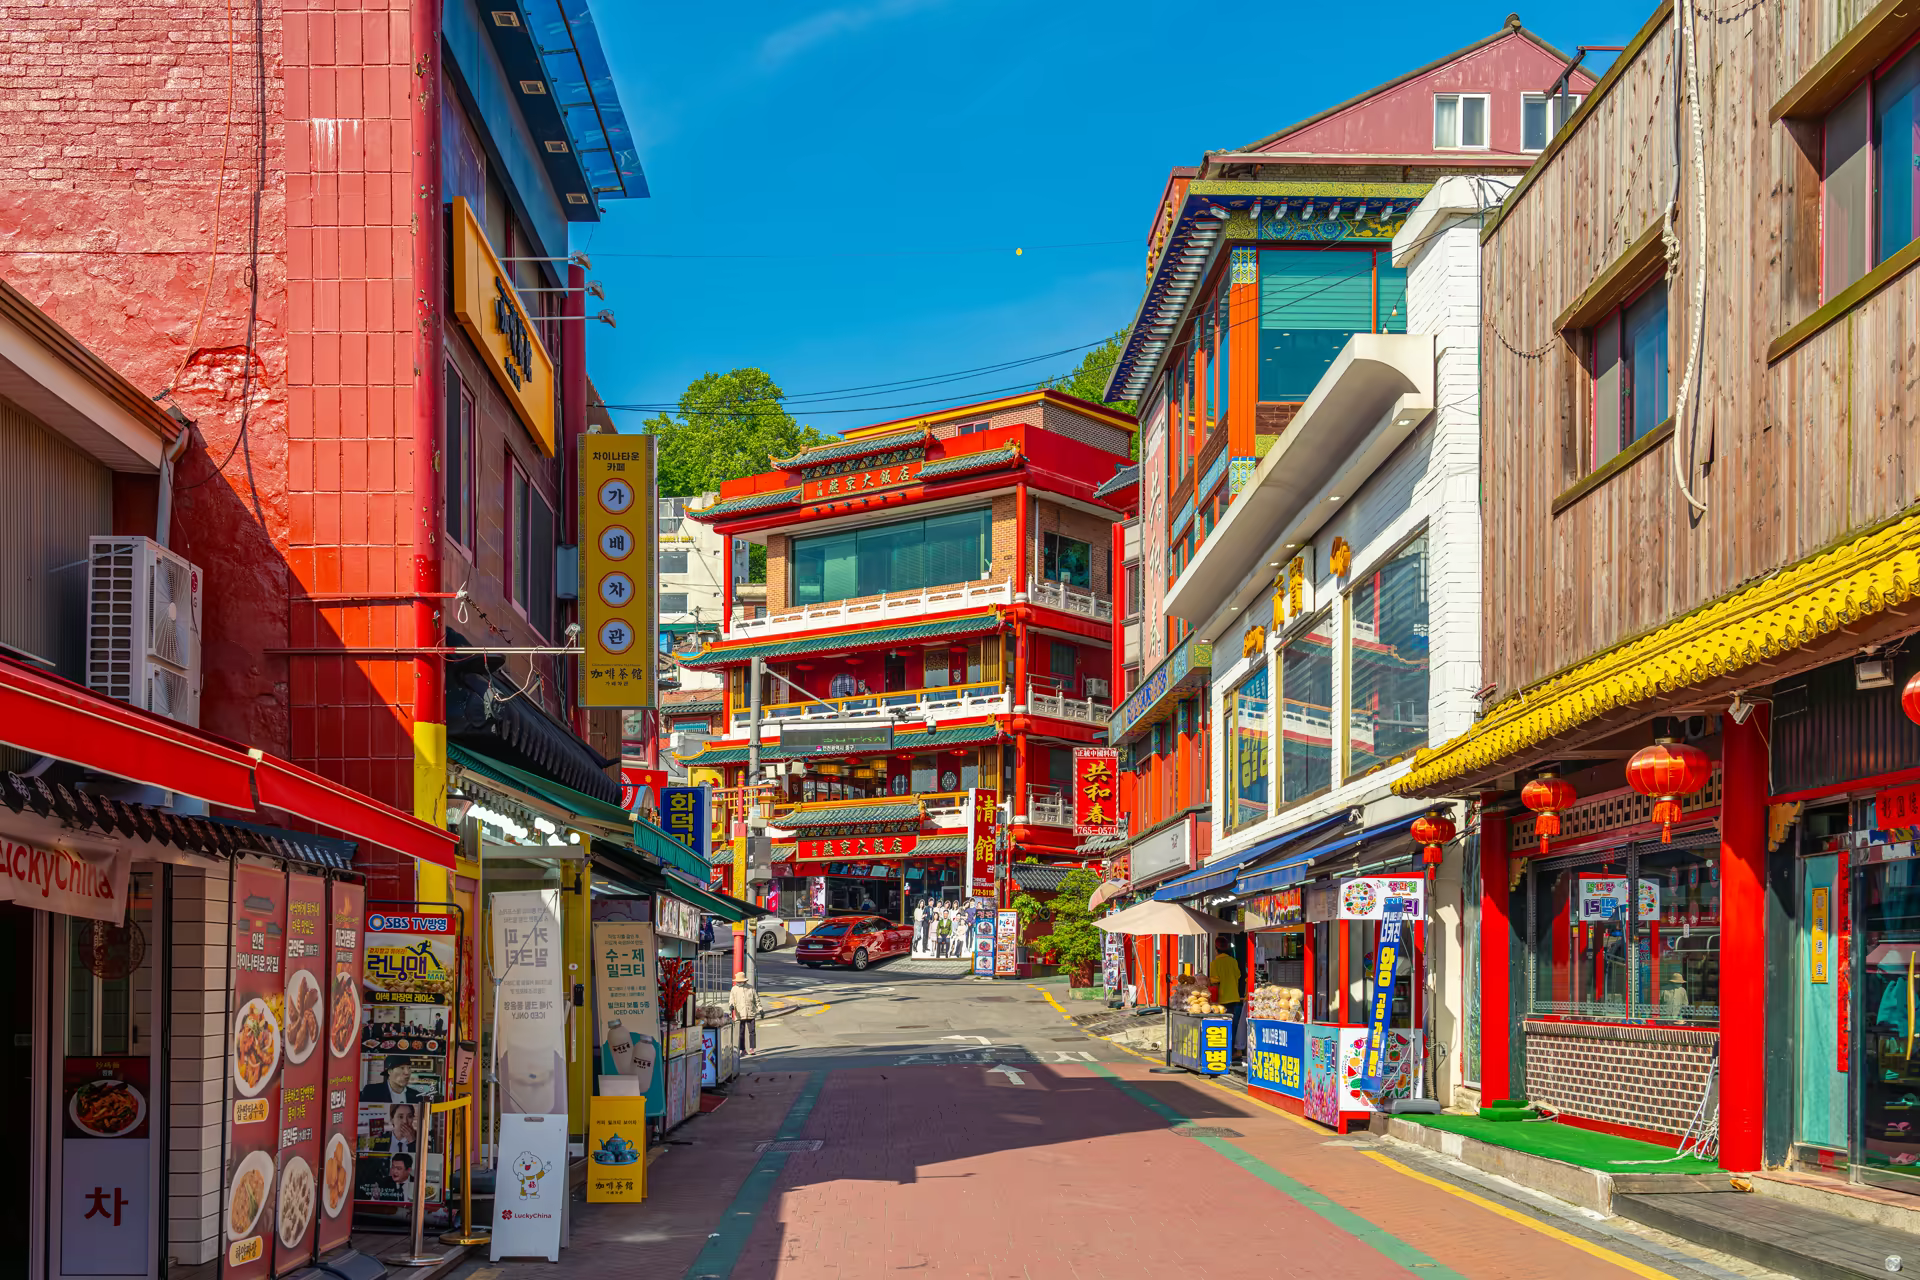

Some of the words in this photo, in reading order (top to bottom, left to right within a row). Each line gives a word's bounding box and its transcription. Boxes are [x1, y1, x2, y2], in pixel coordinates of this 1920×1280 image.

[592, 452, 640, 461] 차이나타운
[607, 462, 625, 472] 카페
[1082, 760, 1114, 824] 共和春
[1078, 827, 1116, 835] 765-0571
[1388, 881, 1417, 893] 생과일
[386, 917, 410, 929] SBS
[412, 918, 447, 931] TV방영
[252, 932, 264, 950] 인천
[237, 952, 265, 972] 차이나타운
[266, 956, 280, 972] 맛집
[367, 955, 427, 981] 런닝맨
[607, 964, 645, 978] 밀크티
[375, 992, 390, 1002] 이색
[391, 993, 413, 1003] 짜장면
[414, 994, 435, 1003] 레이스
[1206, 1026, 1228, 1071] 월병
[237, 1102, 264, 1120] 찹쌀탕수육
[84, 1187, 129, 1227] 차
